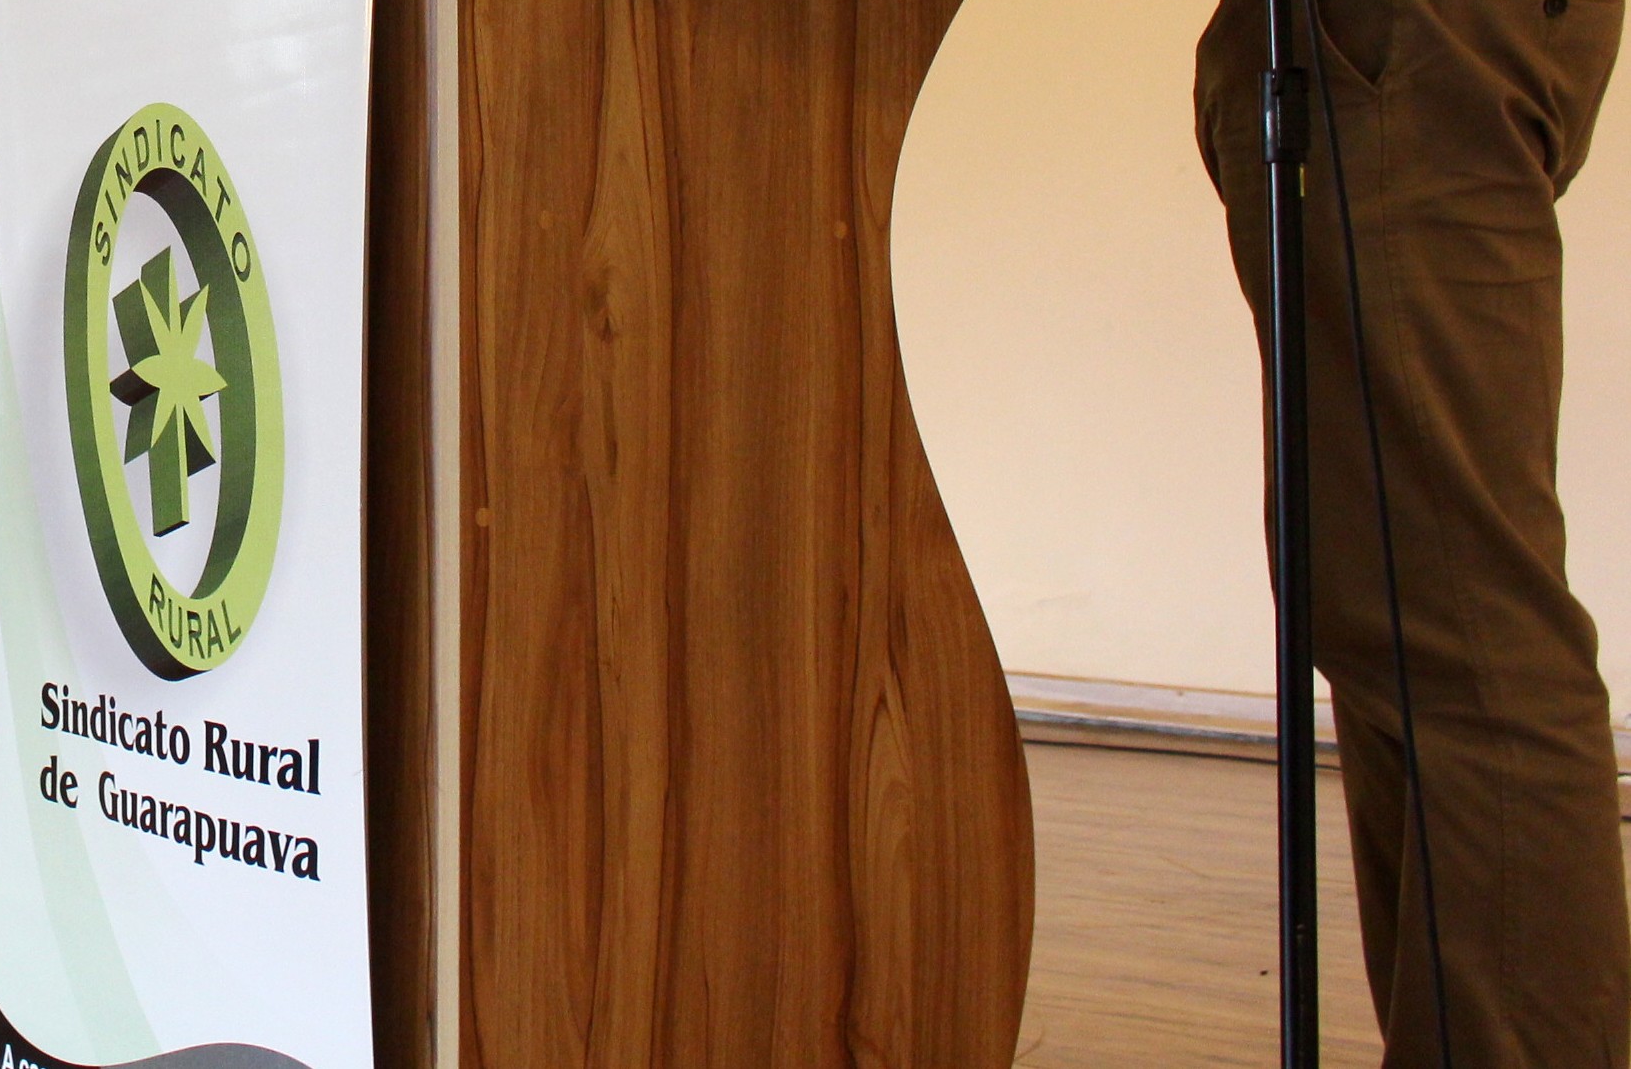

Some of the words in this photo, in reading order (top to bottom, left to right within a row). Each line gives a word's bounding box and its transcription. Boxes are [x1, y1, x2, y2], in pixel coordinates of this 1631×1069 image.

[93, 118, 252, 283] SINDICATO
[147, 571, 243, 661] RURAL
[40, 681, 191, 766] Sindicato
[203, 719, 322, 796] Rural
[39, 754, 79, 809] de
[98, 770, 321, 882] Guarapuava
